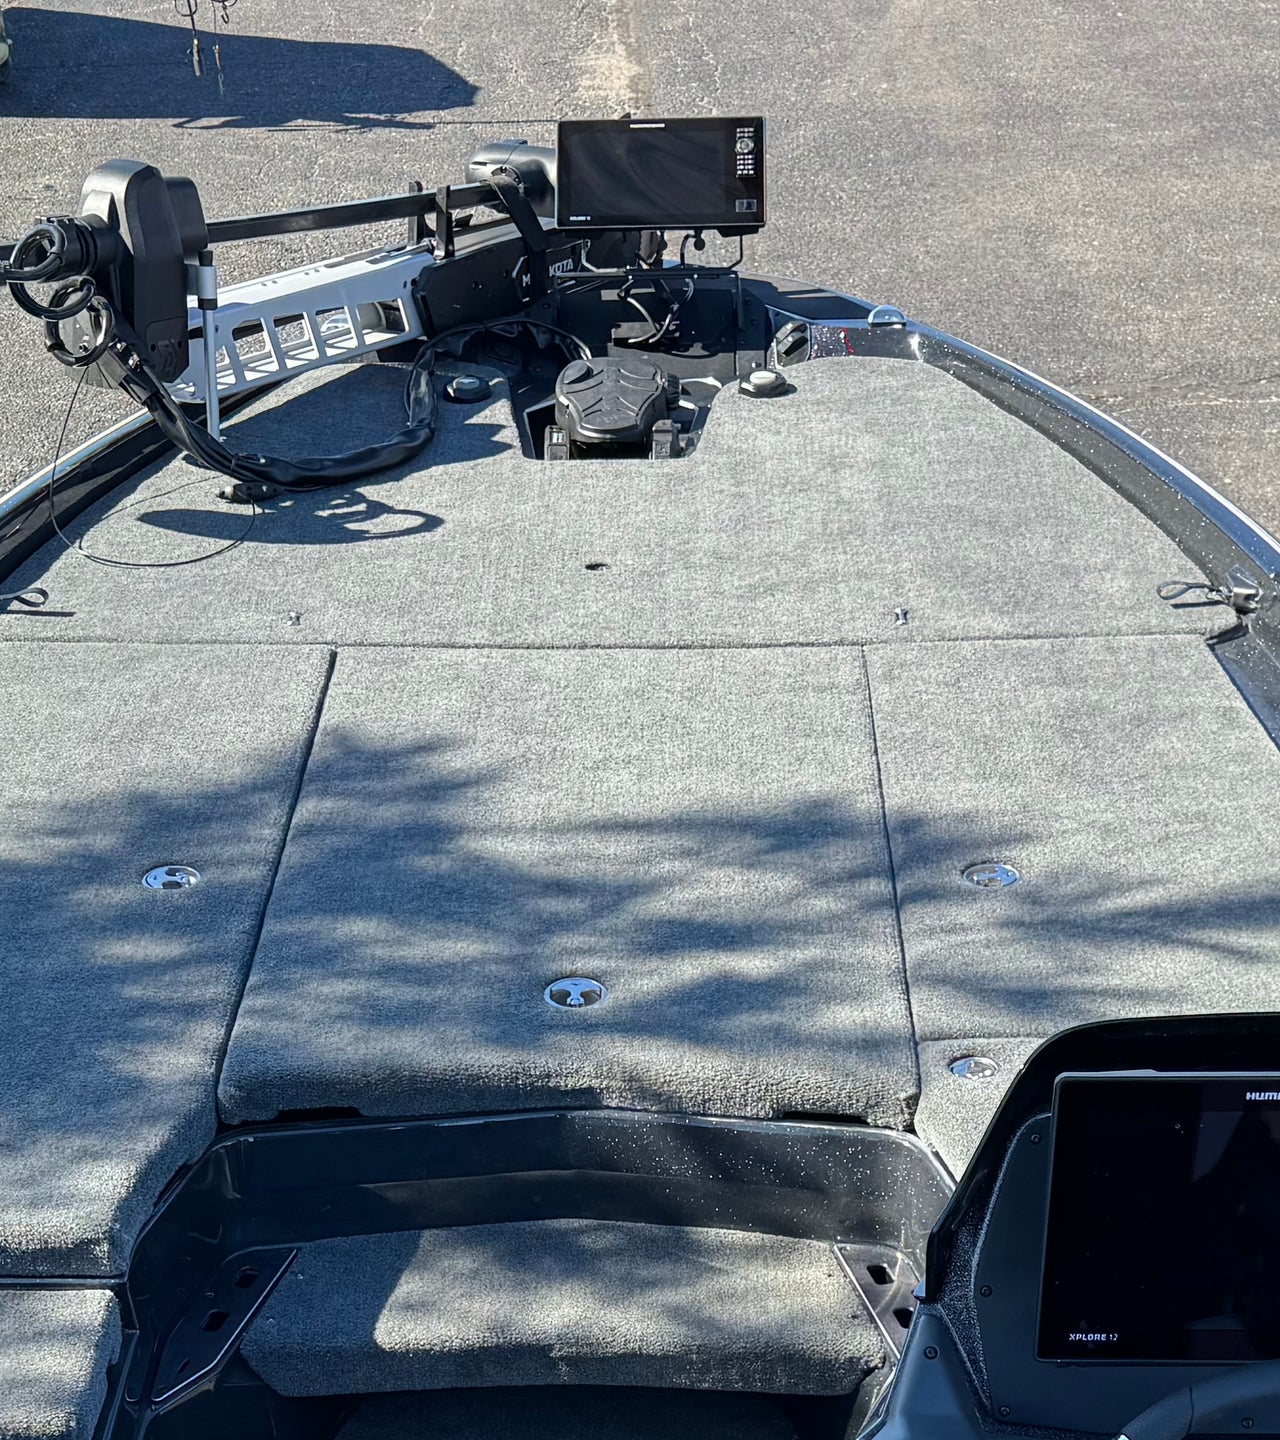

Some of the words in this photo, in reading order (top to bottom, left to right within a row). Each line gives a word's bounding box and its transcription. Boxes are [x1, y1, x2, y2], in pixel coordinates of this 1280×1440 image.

[549, 258, 574, 277] KOTA
[1068, 1333, 1107, 1341] XPLORE
[1109, 1333, 1118, 1341] 12
